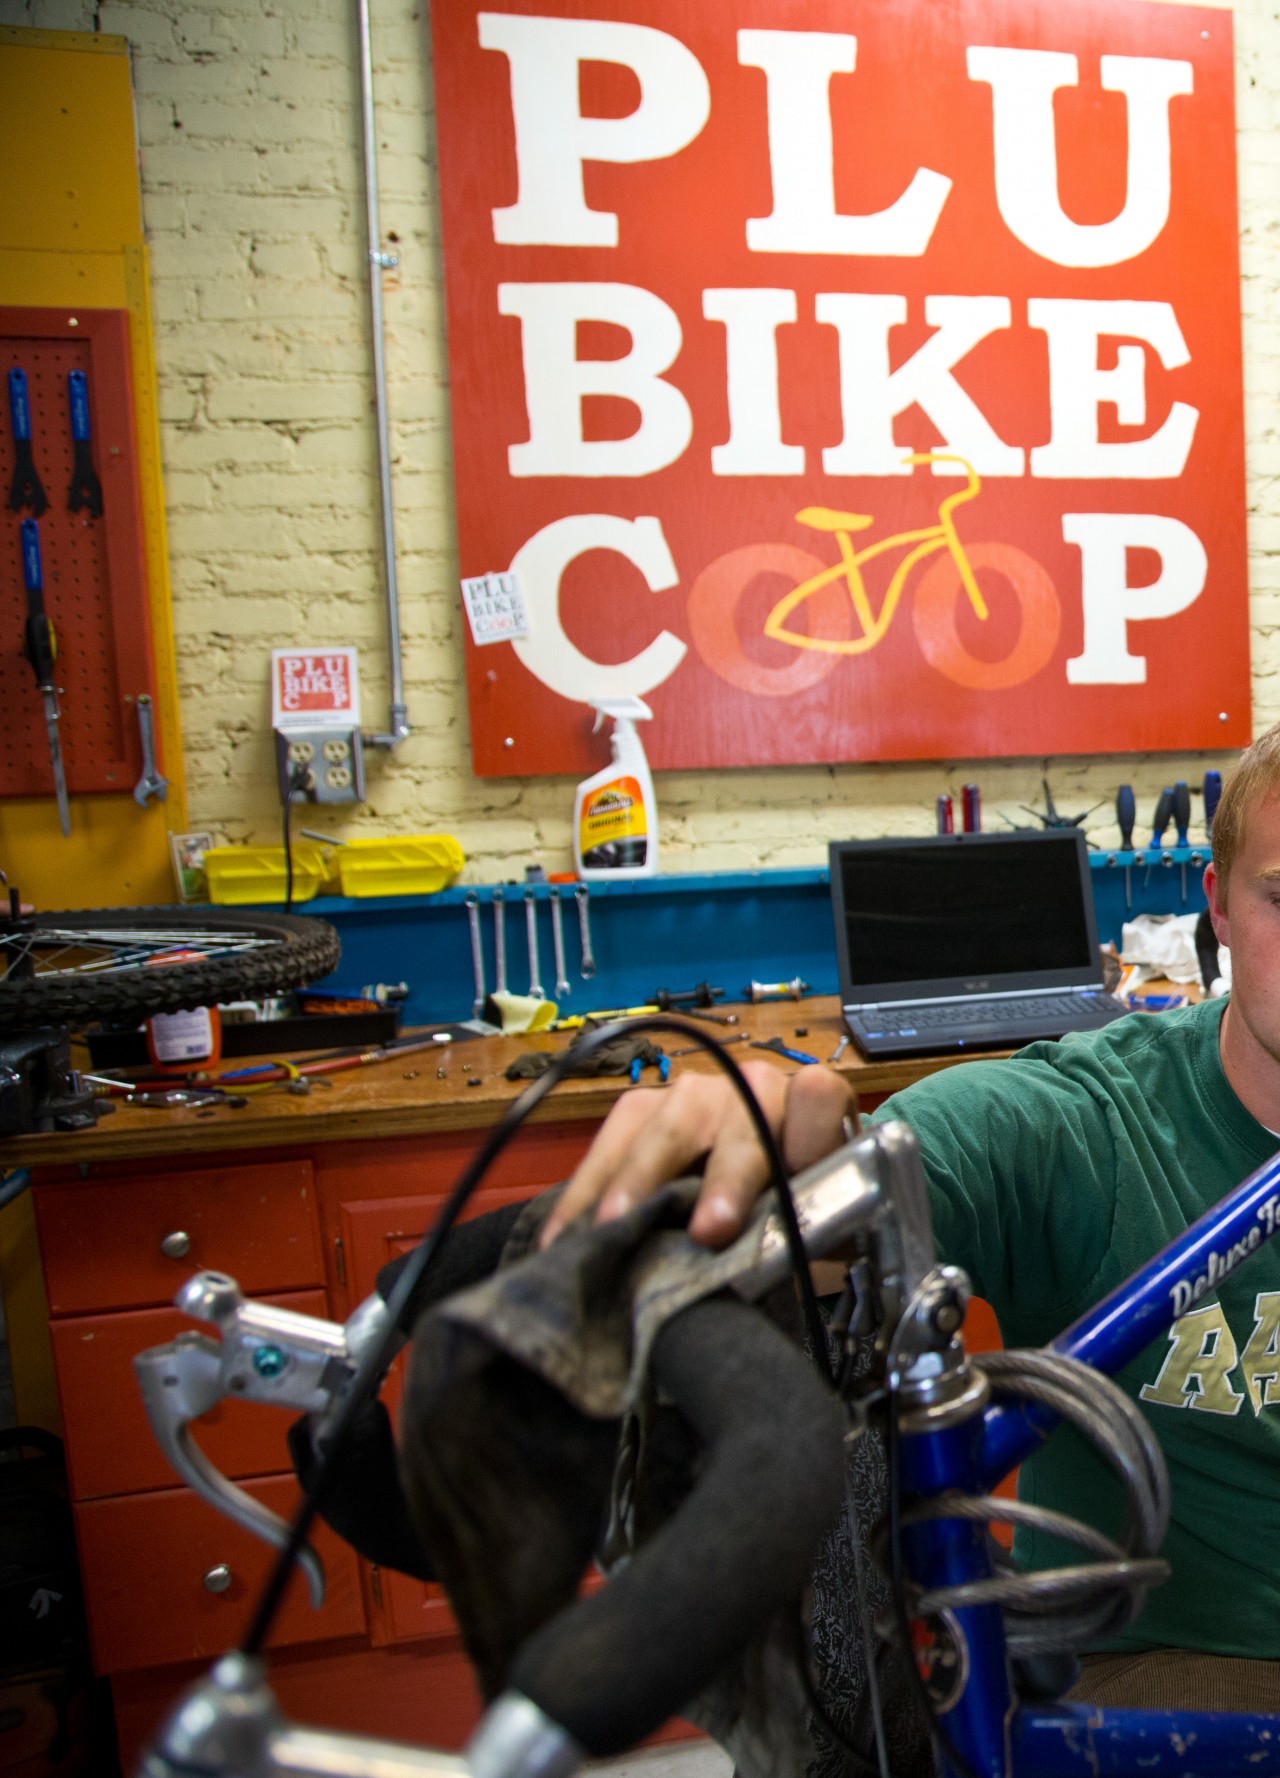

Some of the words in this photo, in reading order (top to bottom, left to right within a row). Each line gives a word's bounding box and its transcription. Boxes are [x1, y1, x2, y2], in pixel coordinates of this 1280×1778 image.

[478, 13, 1194, 268] PLU
[497, 282, 1200, 478] BIKE
[468, 574, 517, 599] PLU
[472, 596, 522, 617] BIKE
[283, 657, 344, 675] PLU
[284, 673, 347, 693] BIKE
[1168, 1225, 1261, 1319] Deluxe
